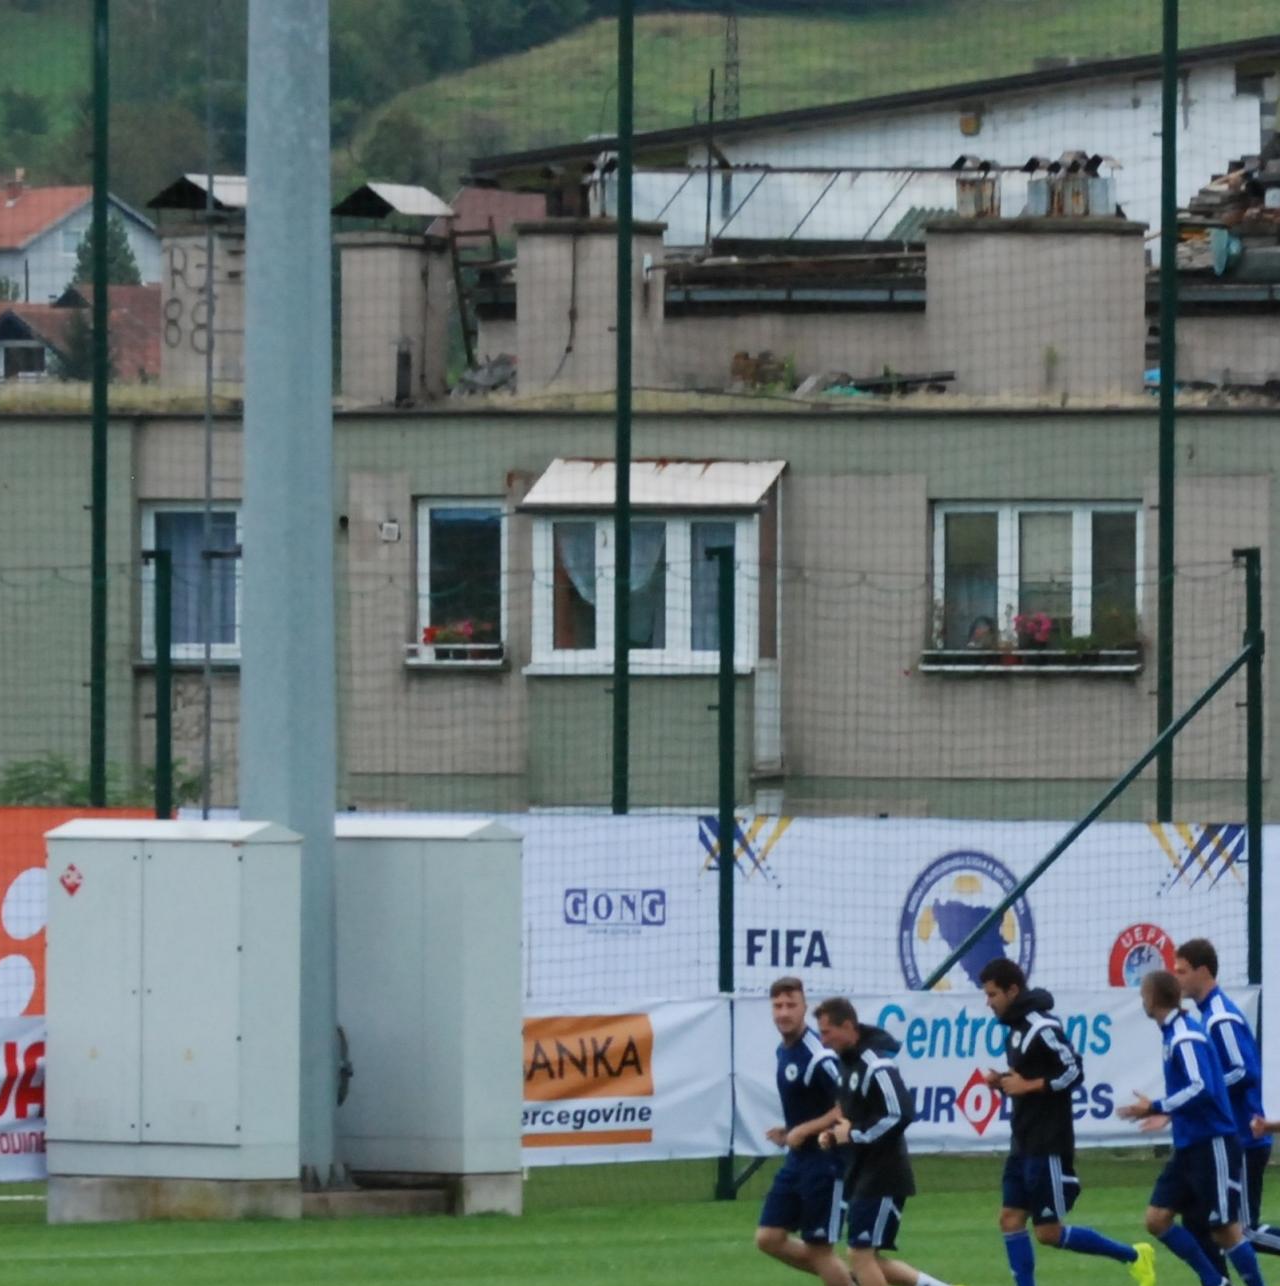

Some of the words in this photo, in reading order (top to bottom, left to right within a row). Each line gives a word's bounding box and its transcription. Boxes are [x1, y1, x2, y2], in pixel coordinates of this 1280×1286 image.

[565, 889, 666, 926] GONG
[746, 929, 831, 968] FIFA
[1121, 926, 1166, 950] UEFA
[876, 1004, 1112, 1058] Centrons
[524, 1035, 643, 1081] ANKA
[521, 1102, 652, 1130] ercegovine
